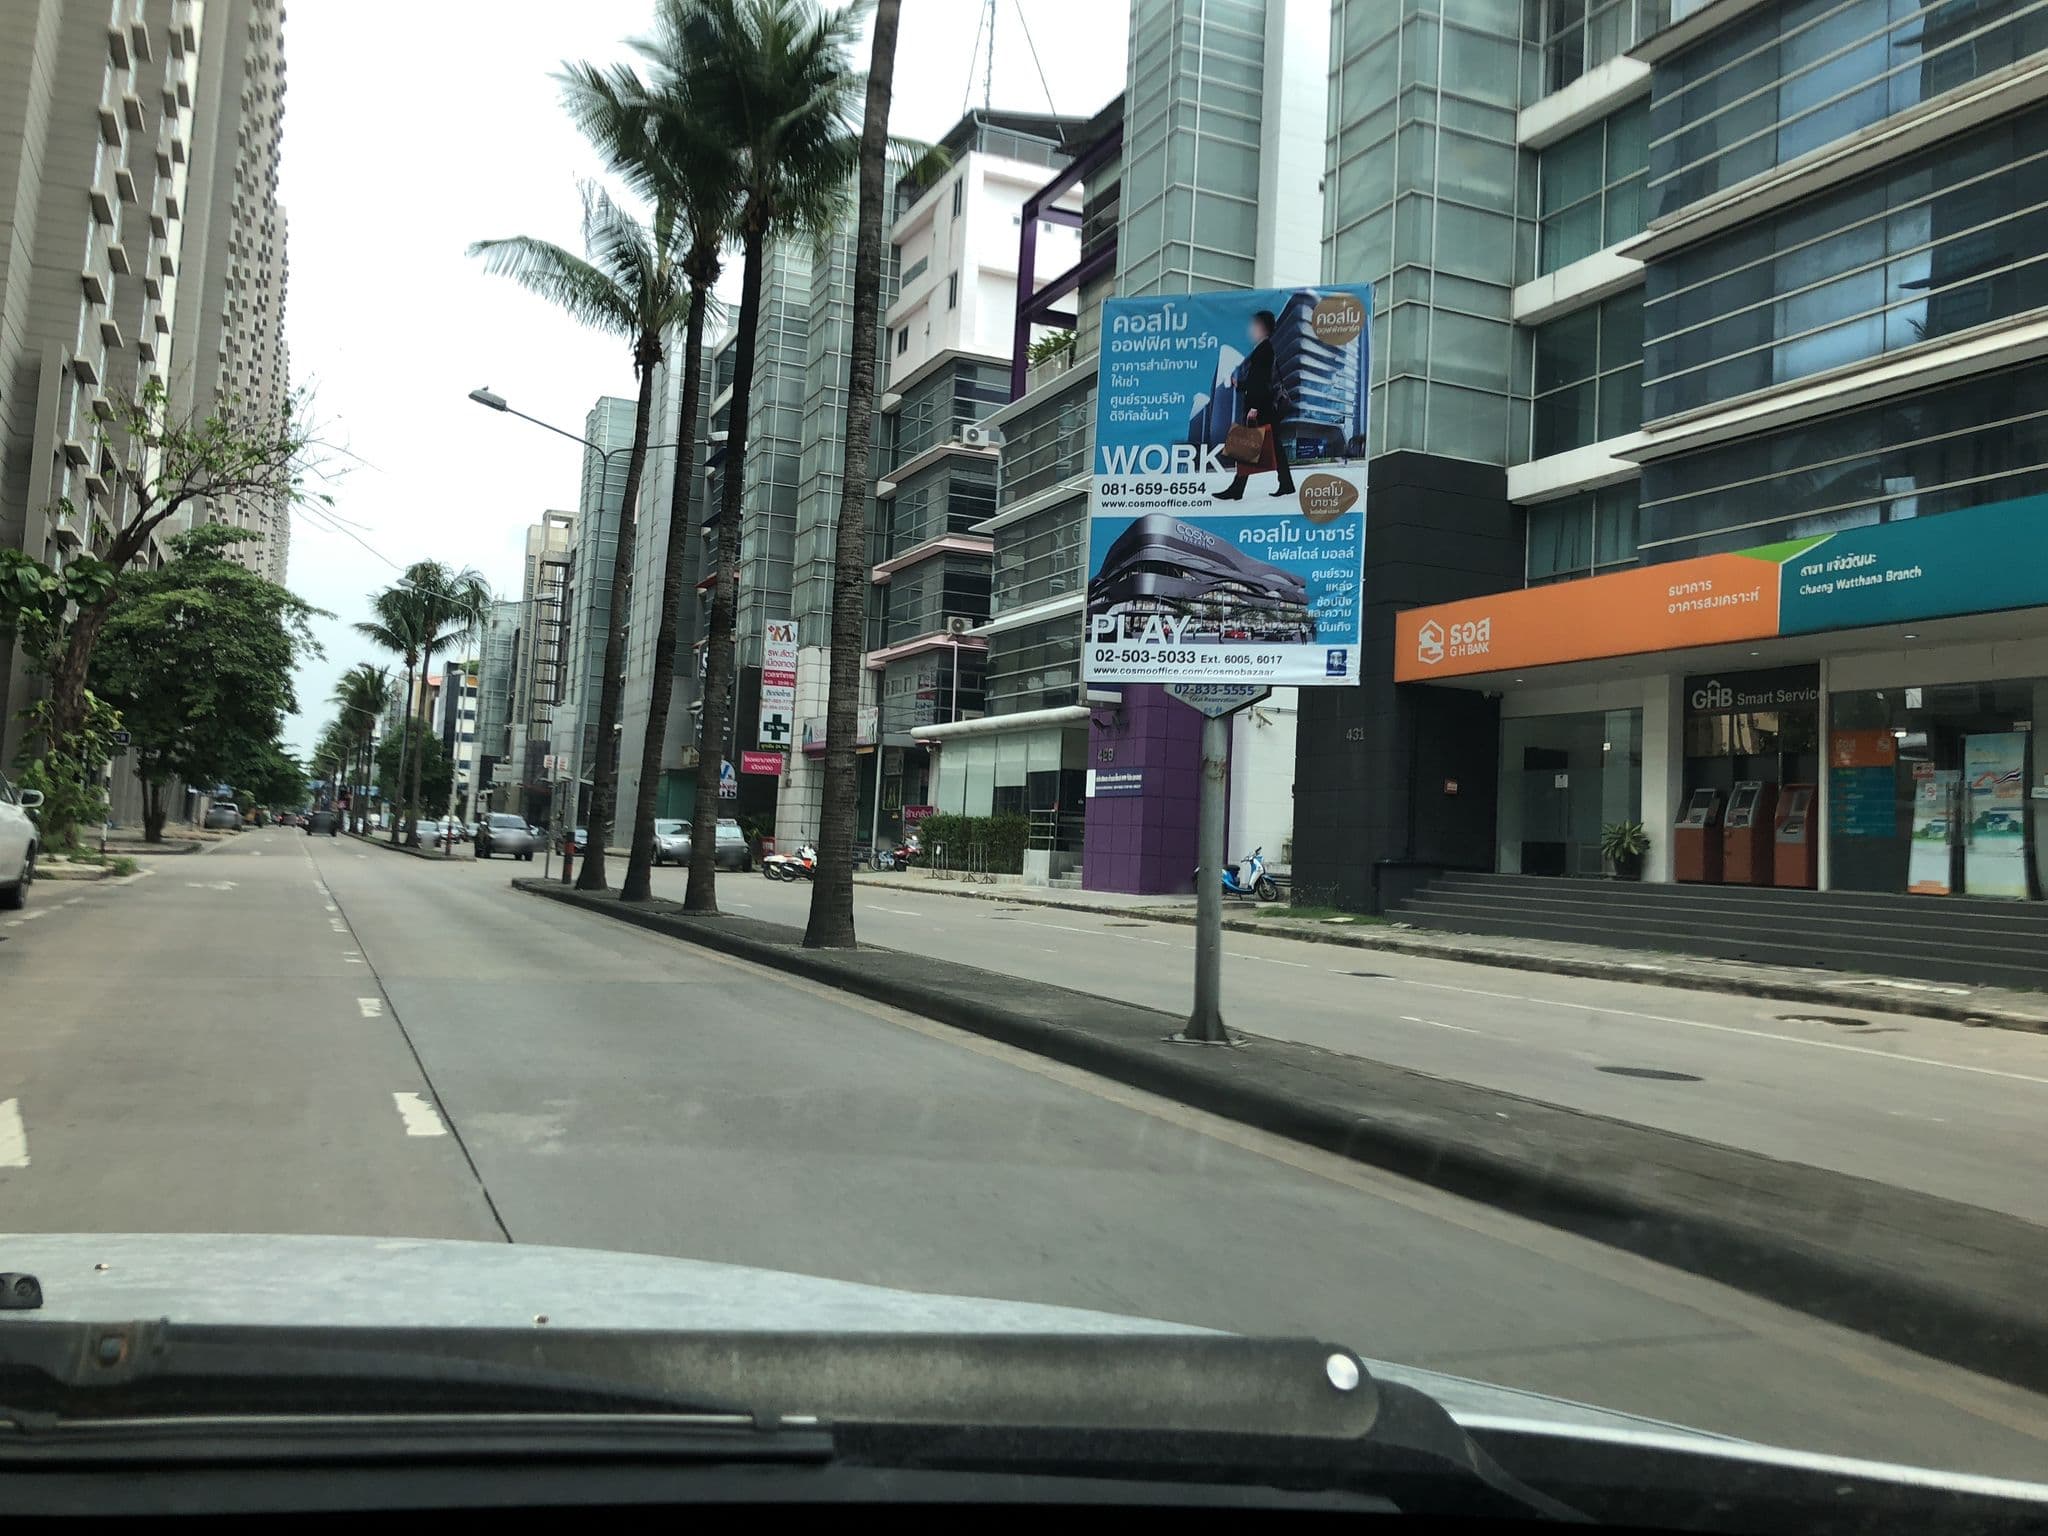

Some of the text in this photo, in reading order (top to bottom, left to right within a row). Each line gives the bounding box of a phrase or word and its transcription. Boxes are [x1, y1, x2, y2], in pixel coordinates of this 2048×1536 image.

[1113, 303, 1188, 334] คอสโม
[1316, 307, 1361, 326] คอสโม
[1111, 332, 1218, 352] ออฟฟิศ พาร์ค
[1111, 358, 1198, 372] อาคารสำนักงาน
[1111, 373, 1140, 388] ให้เช่า
[1110, 391, 1185, 408] ศูนย์รวมบริษัท
[1101, 443, 1226, 475] WORK
[1101, 482, 1206, 496] 081-659-6554
[1101, 499, 1212, 508] www.cosmooffice.com
[1238, 520, 1356, 543] คอสโม บาซาร์
[1267, 546, 1355, 561] ไลฟ์สไตล์ มอลล์
[1311, 569, 1355, 582] ศูนย์รวม
[1799, 565, 1923, 595] Chaeng Watthana Branch
[1668, 580, 1712, 597] ธนาคาร
[1668, 586, 1761, 614] อาคารสงเคราะห์
[1091, 614, 1192, 645] PLAY
[1095, 649, 1283, 665] 02-503-5033 Ext. 6005, 6017
[1467, 642, 1489, 655] BANK
[1093, 666, 1275, 677] www.cosmooffice.com/cosmobazaar
[1692, 685, 1733, 709] GHB
[1737, 691, 1773, 706] Smart
[1345, 727, 1365, 741] 431
